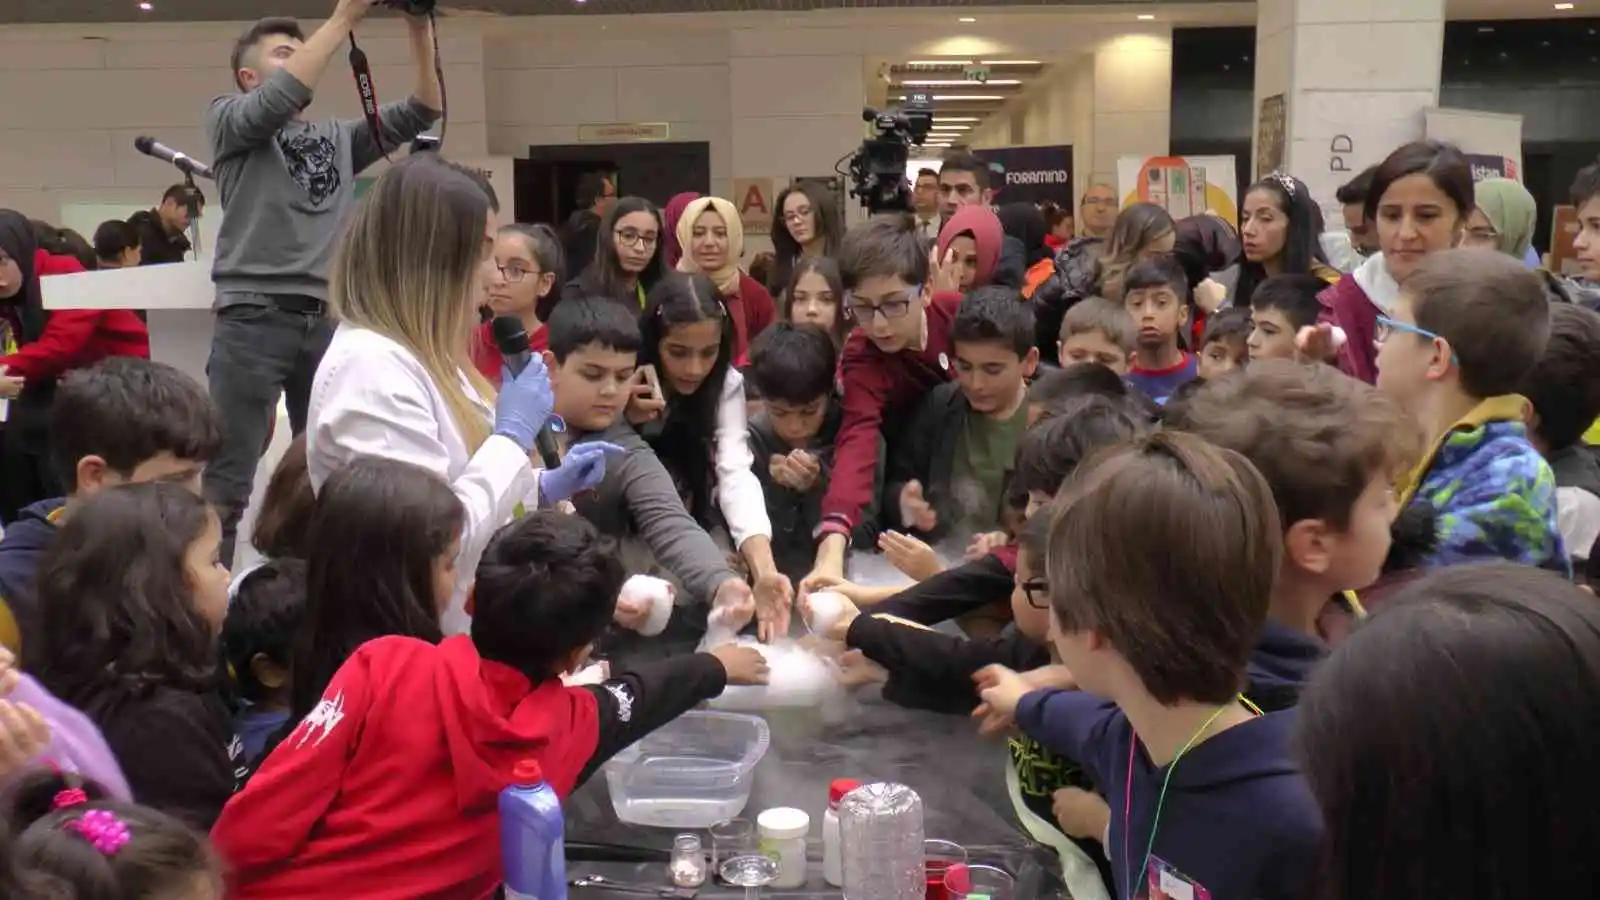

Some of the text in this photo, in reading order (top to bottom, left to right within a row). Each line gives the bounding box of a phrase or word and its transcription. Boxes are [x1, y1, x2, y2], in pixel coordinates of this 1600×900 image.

[1331, 135, 1352, 171] PD
[1006, 170, 1067, 184] FORAMIND
[741, 184, 767, 215] A
